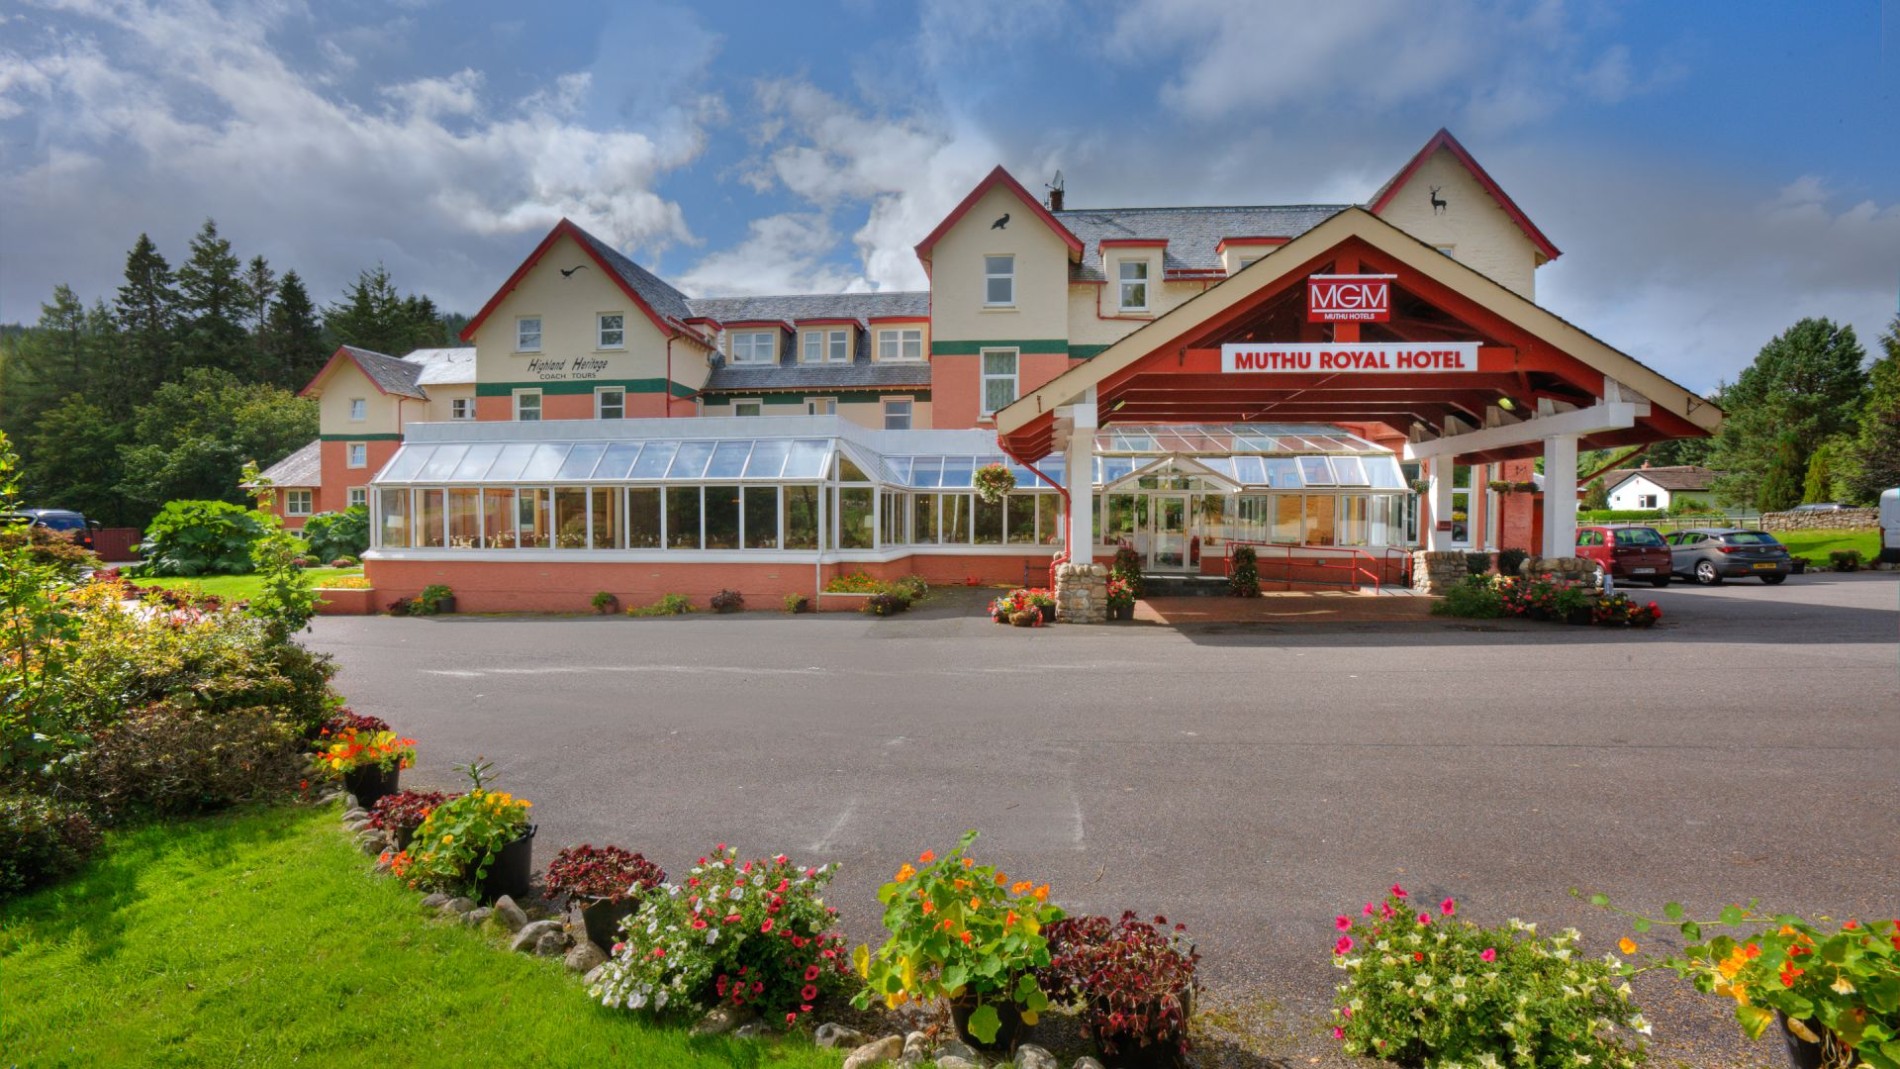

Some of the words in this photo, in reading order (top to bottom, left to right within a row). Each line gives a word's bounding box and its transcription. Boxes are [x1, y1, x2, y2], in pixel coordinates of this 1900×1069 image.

[1311, 284, 1387, 308] MGM
[527, 358, 566, 374] Highland
[571, 356, 608, 372] Heritage
[1234, 352, 1311, 370] MUTHU
[1319, 351, 1390, 369] ROYAL
[1397, 351, 1465, 369] HOTEL
